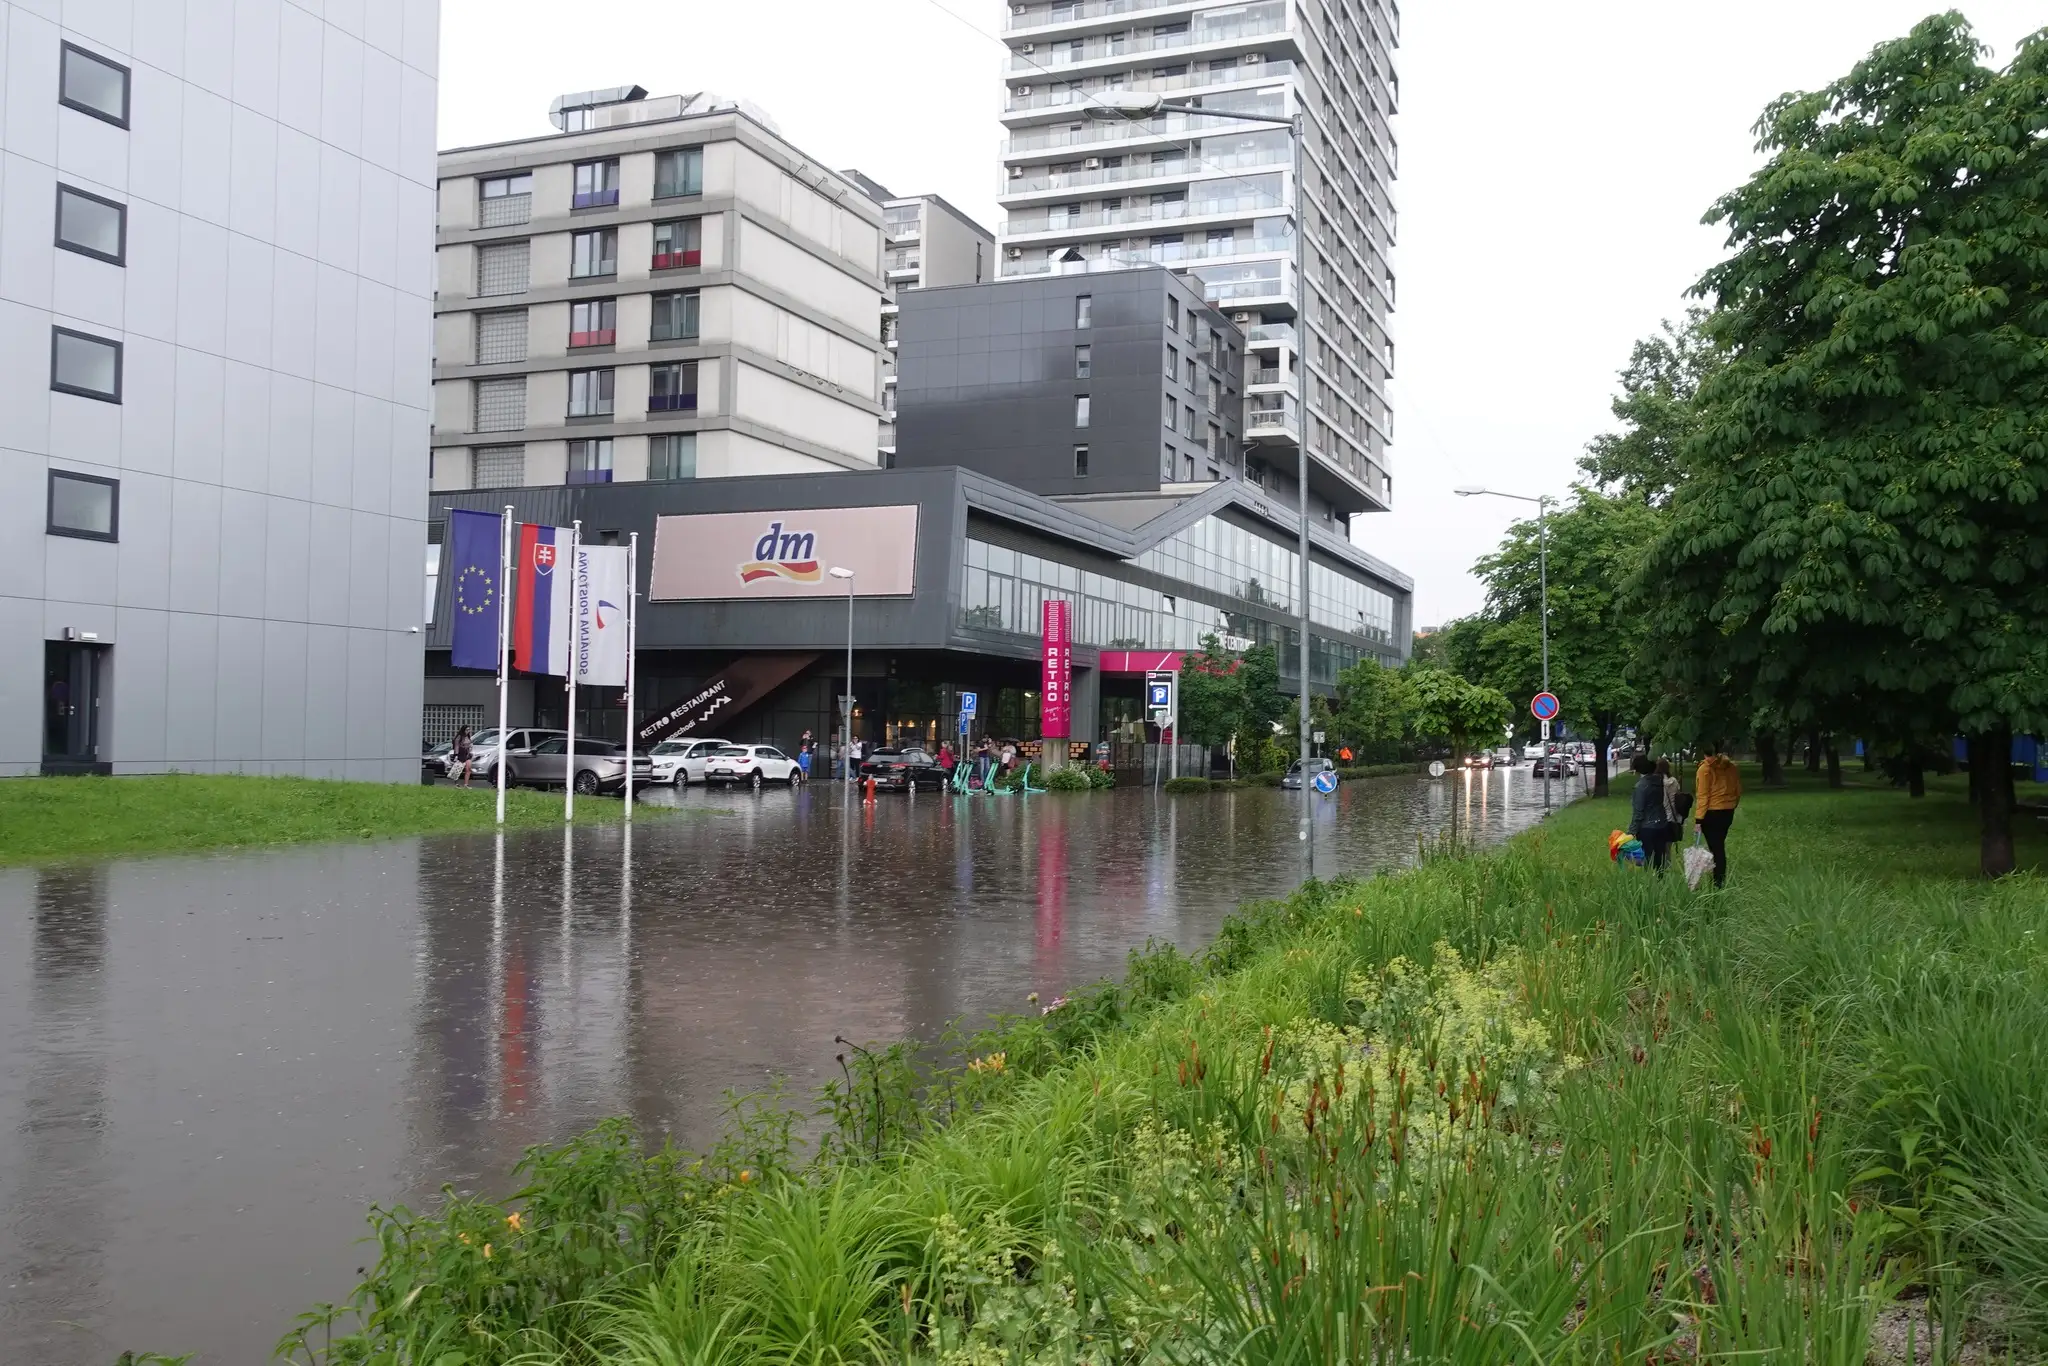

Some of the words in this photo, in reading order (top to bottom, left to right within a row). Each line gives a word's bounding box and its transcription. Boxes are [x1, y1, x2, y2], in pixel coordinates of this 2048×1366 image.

[756, 522, 814, 561] dm
[1047, 648, 1059, 702] RETRO
[1063, 648, 1071, 702] RETRO
[639, 716, 670, 739] RETRO
[670, 679, 726, 720] RESTAURANT
